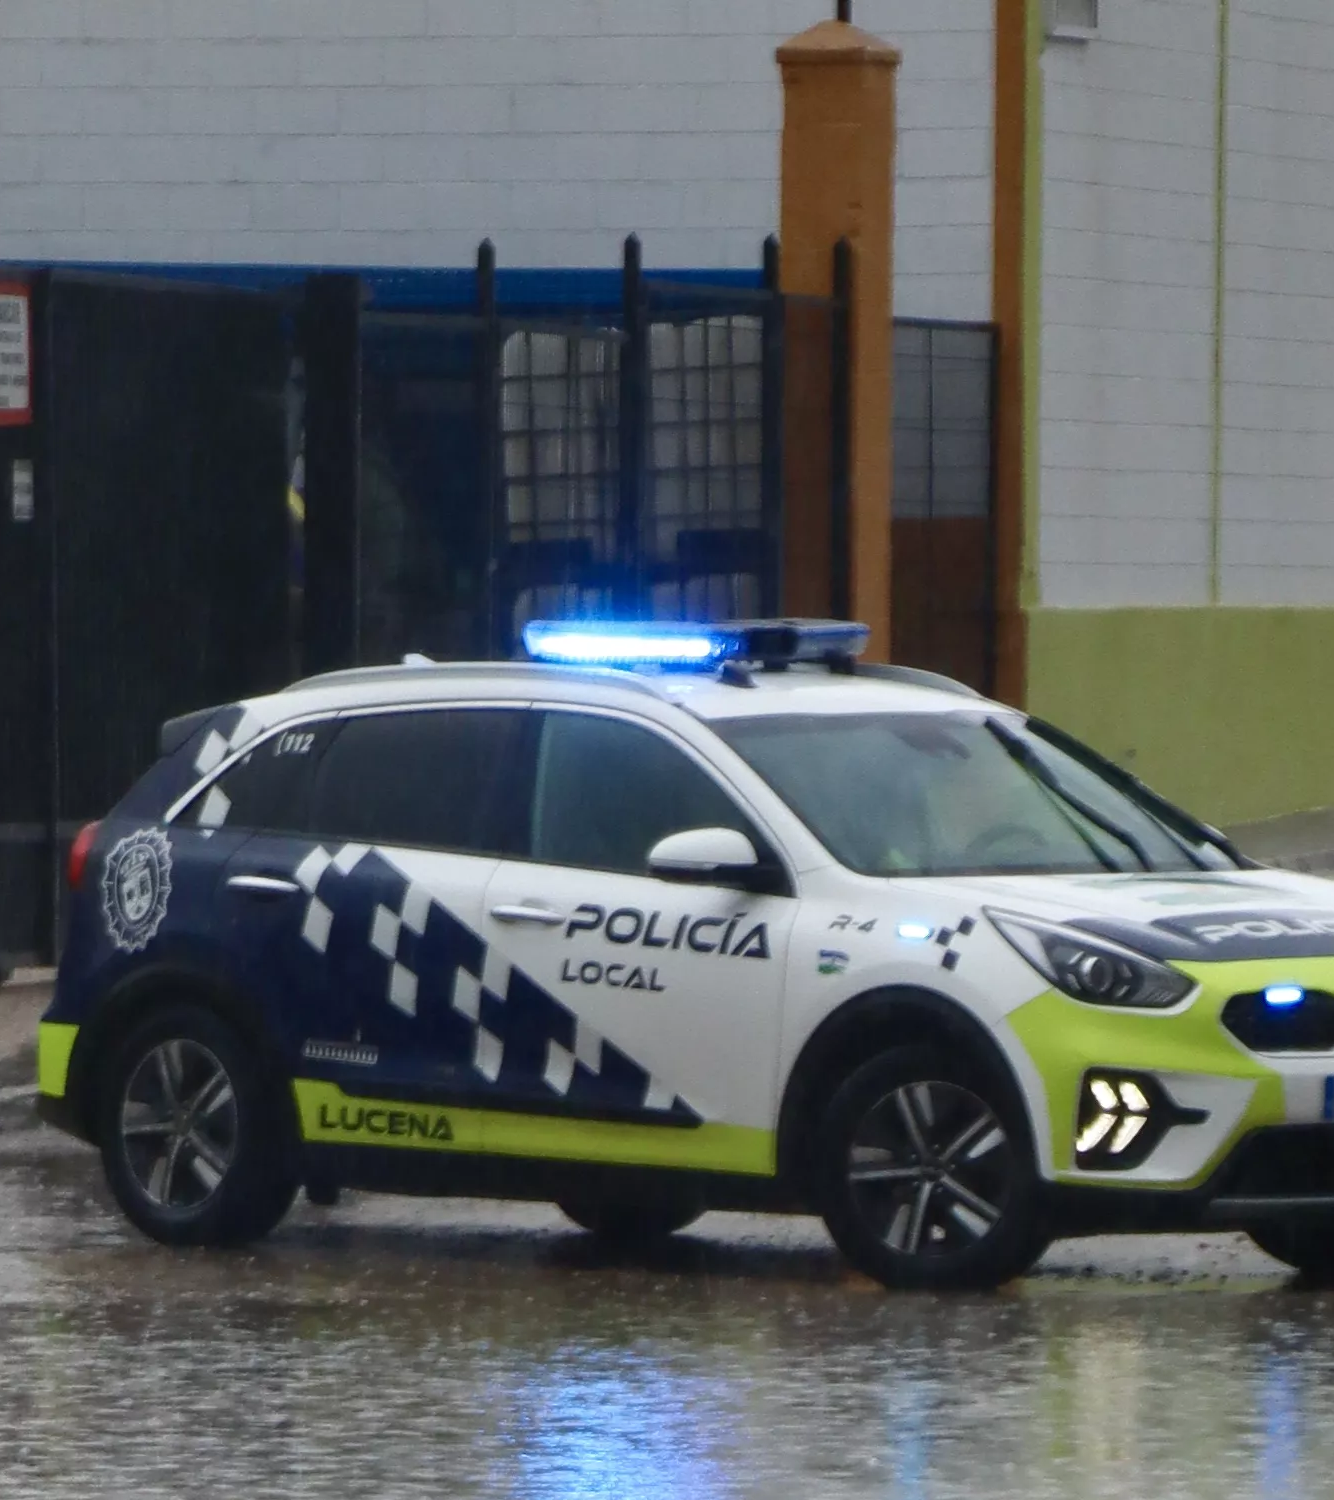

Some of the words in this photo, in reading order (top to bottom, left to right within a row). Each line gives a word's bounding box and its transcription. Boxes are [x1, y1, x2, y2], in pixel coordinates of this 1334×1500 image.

[566, 903, 771, 959] POLICÍA
[561, 958, 666, 992] LOCAL
[319, 1103, 454, 1141] LUCENA
